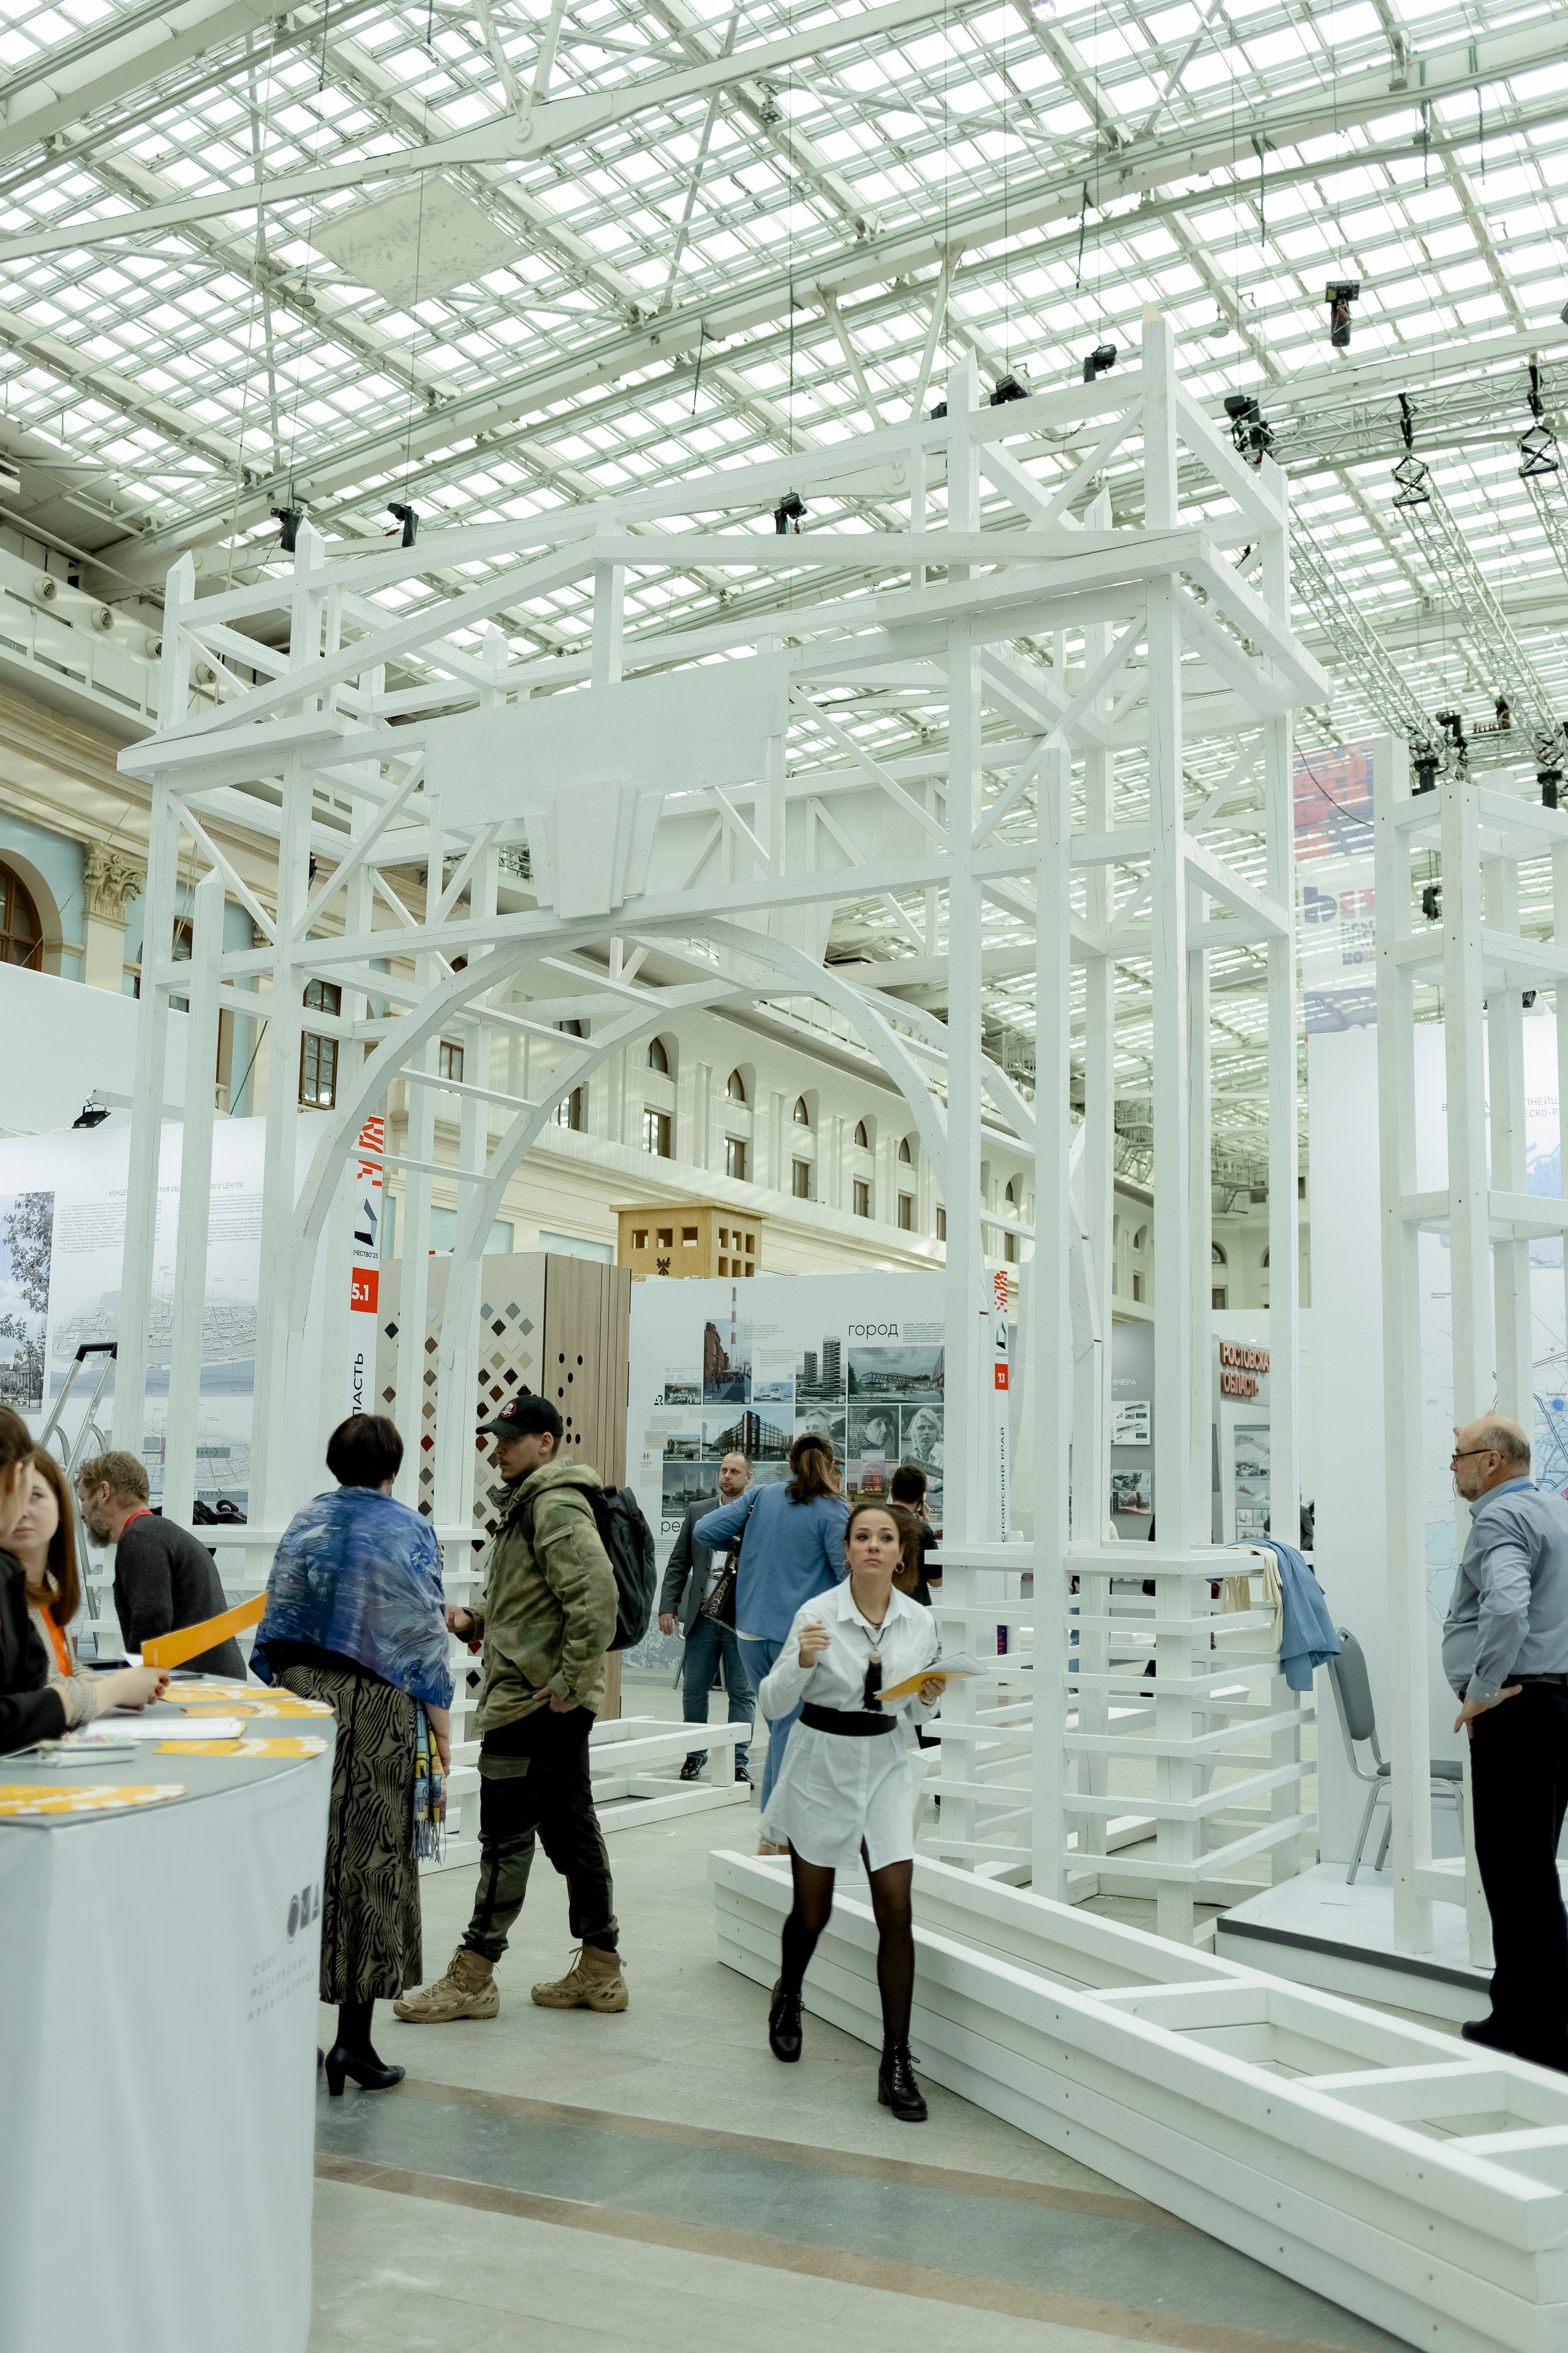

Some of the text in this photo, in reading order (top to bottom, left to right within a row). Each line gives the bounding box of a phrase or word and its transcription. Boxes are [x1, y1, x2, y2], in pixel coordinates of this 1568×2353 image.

[353, 1249, 379, 1258] ЧЕСТВО'23
[352, 1282, 369, 1301] 5.1
[848, 1324, 899, 1340] город
[1223, 1344, 1270, 1372] РОСТОВСКА
[1224, 1373, 1259, 1397] ОБЛАСТЬ
